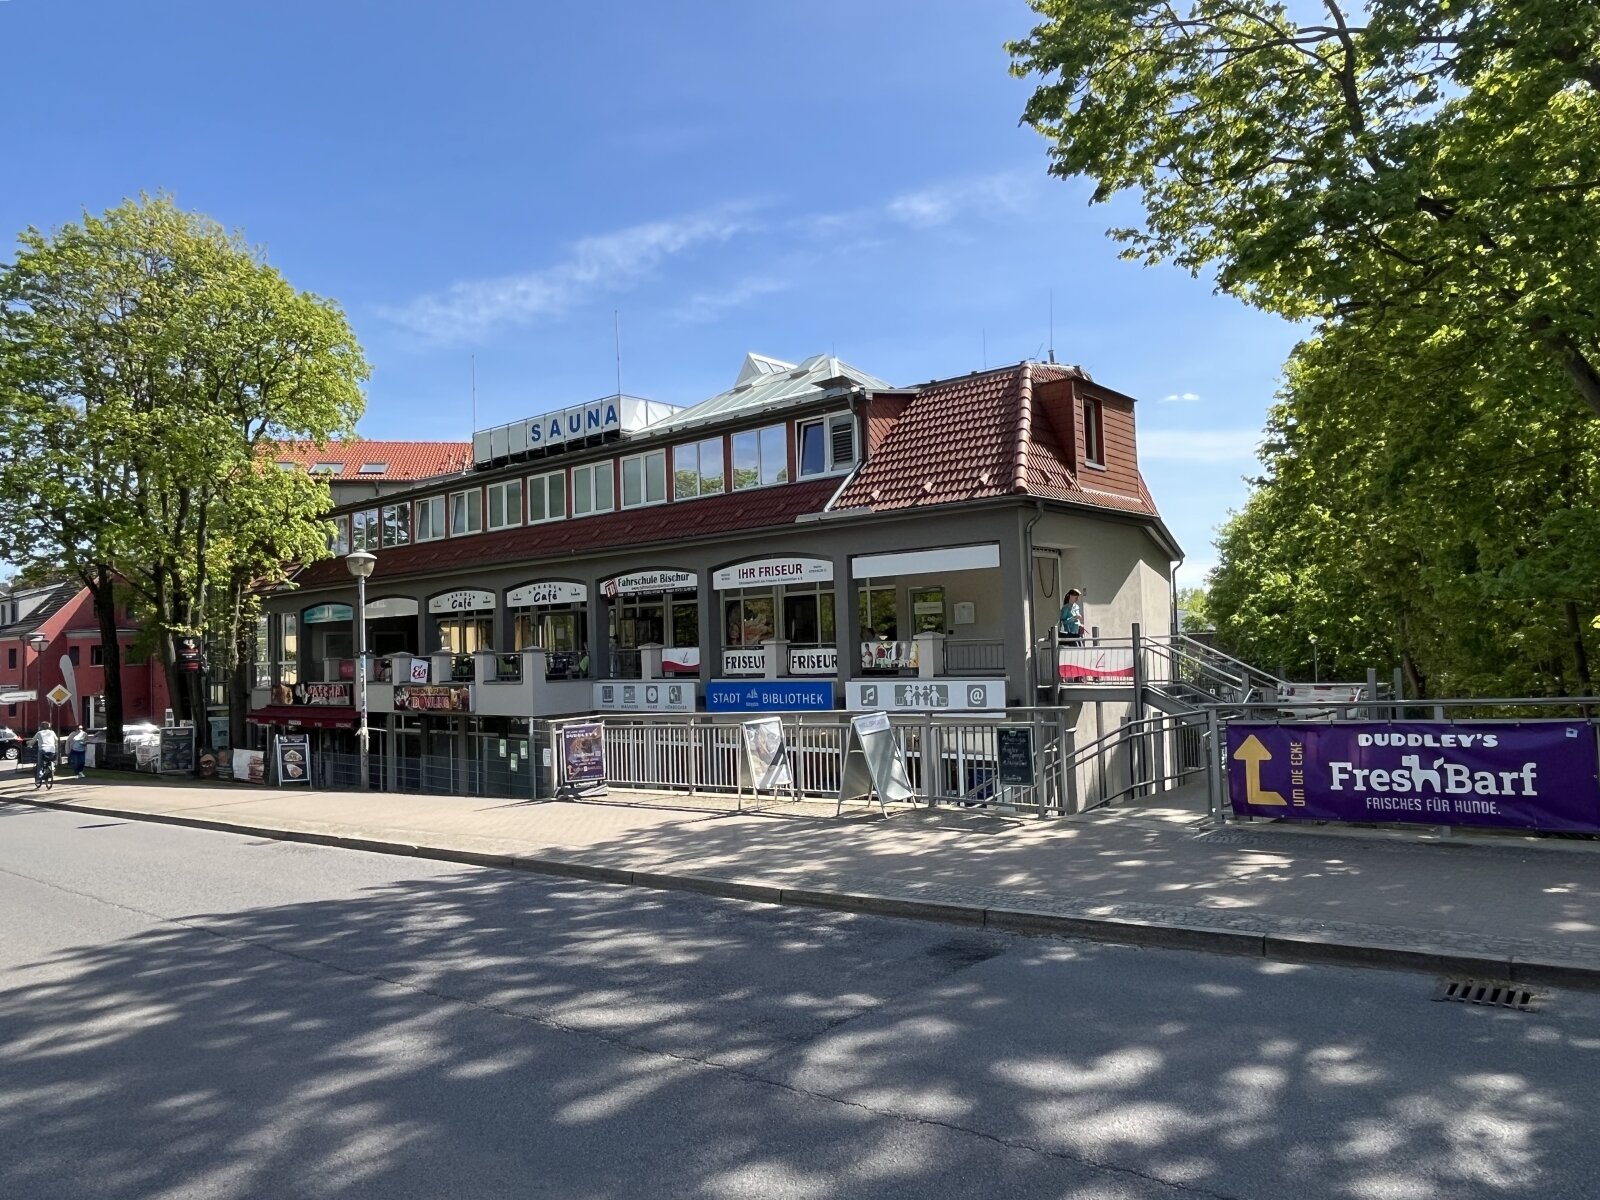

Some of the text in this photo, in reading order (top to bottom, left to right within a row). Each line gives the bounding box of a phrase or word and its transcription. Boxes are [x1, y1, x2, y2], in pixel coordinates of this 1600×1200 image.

[531, 404, 618, 442] SAUNA
[738, 568, 756, 579] IHR
[759, 563, 803, 577] FRISEUR
[617, 575, 658, 587] Fahrschule
[451, 597, 472, 609] Café
[533, 590, 558, 602] Café
[791, 654, 838, 669] FRISEUR
[412, 665, 427, 680] Eis
[712, 692, 741, 704] STADT
[762, 692, 824, 705] BIBLIOTHEK
[1357, 733, 1498, 748] DUDDLEY'S
[1290, 741, 1306, 807] UM DIE ECKE
[1366, 797, 1501, 815] FRISCHES FÜR HUNDE.
